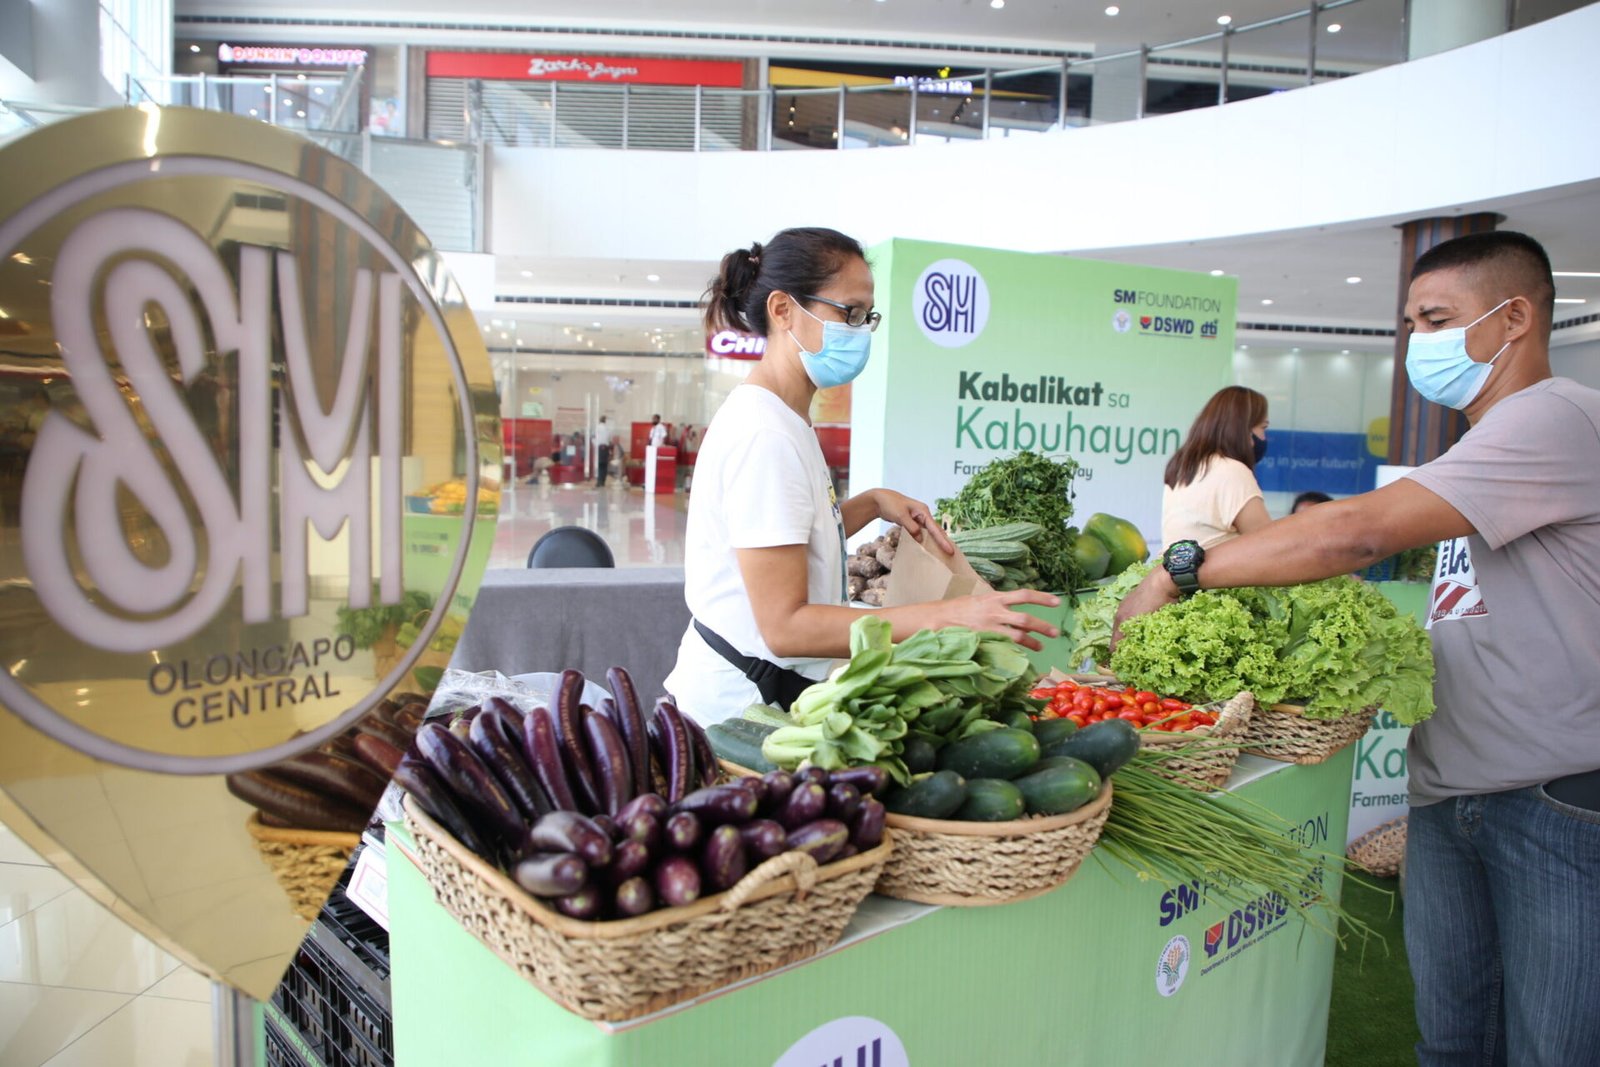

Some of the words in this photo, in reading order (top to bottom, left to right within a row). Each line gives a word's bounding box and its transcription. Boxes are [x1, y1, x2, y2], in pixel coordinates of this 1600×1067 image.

[299, 48, 365, 64] DONUTS
[923, 272, 976, 333] SM
[1113, 289, 1136, 304] SM
[1138, 291, 1222, 313] FOUNDATION
[1154, 316, 1195, 334] DSWD
[958, 370, 1104, 407] Kabalikat
[1108, 392, 1130, 408] sa
[20, 207, 402, 653] SM
[955, 405, 1182, 465] Kabuhayan
[148, 634, 356, 695] OLONGAPO
[172, 671, 340, 729] CENTRAL
[1159, 879, 1200, 927] SM
